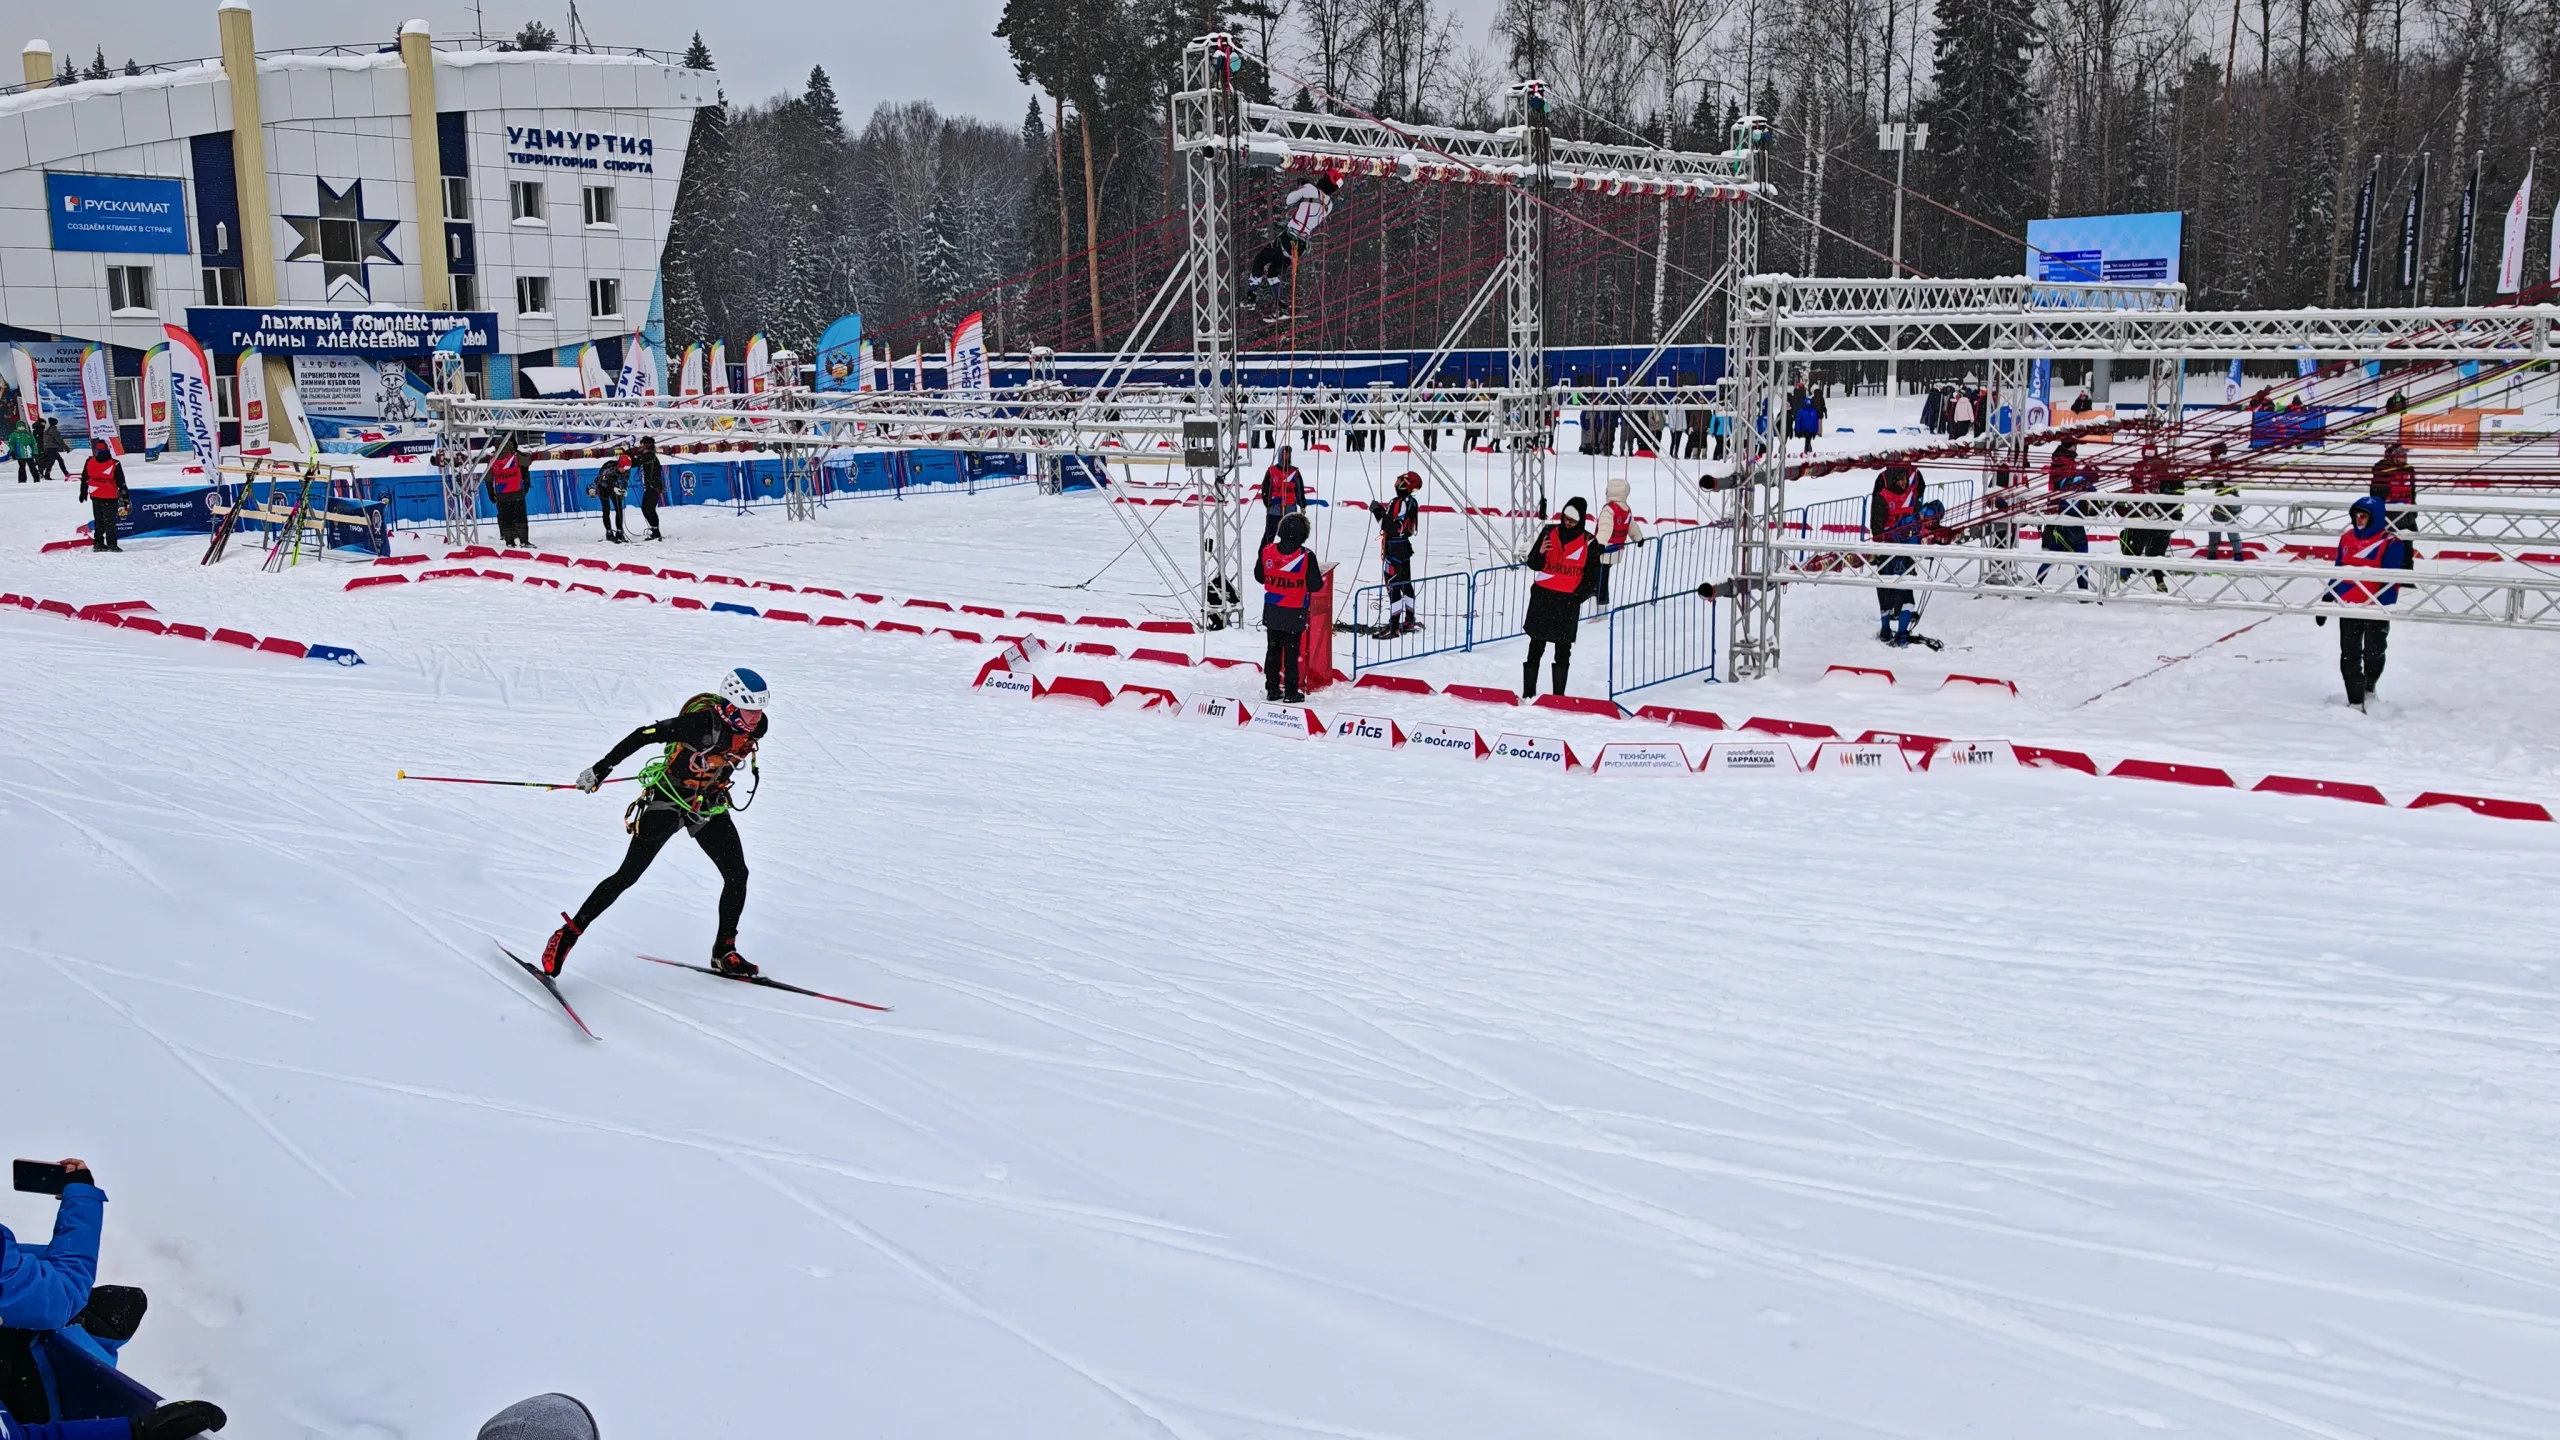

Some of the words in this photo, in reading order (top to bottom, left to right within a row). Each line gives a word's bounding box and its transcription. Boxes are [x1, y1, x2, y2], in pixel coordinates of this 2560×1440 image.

[507, 127, 653, 156] УДМУРТИЯ
[508, 152, 598, 169] ТЕРРИТОРИЯ
[603, 160, 653, 174] СПОРТА
[85, 200, 171, 214] РУСКЛИМАТ
[67, 222, 106, 231] СОЗДАЁМ
[106, 224, 138, 232] КЛИМАТ
[261, 312, 342, 330] ЛЫЖНЫЙ
[353, 314, 429, 331] КОМПЛЕКС
[232, 331, 306, 348] ГАЛИНЫ
[316, 331, 420, 348] АЛЕКСЕЕВНЫ
[403, 445, 436, 454] УСПЕШНЫ
[142, 501, 193, 511] СПОРТИВНЫЙ
[1545, 562, 1584, 577] АНИЗАТО
[995, 681, 1030, 692] ФОСАГРО
[758, 696, 766, 704] 31
[1355, 725, 1383, 739] ПСБ
[1424, 737, 1472, 750] ФОСАГРО
[1510, 749, 1561, 762] ФОСАГРО
